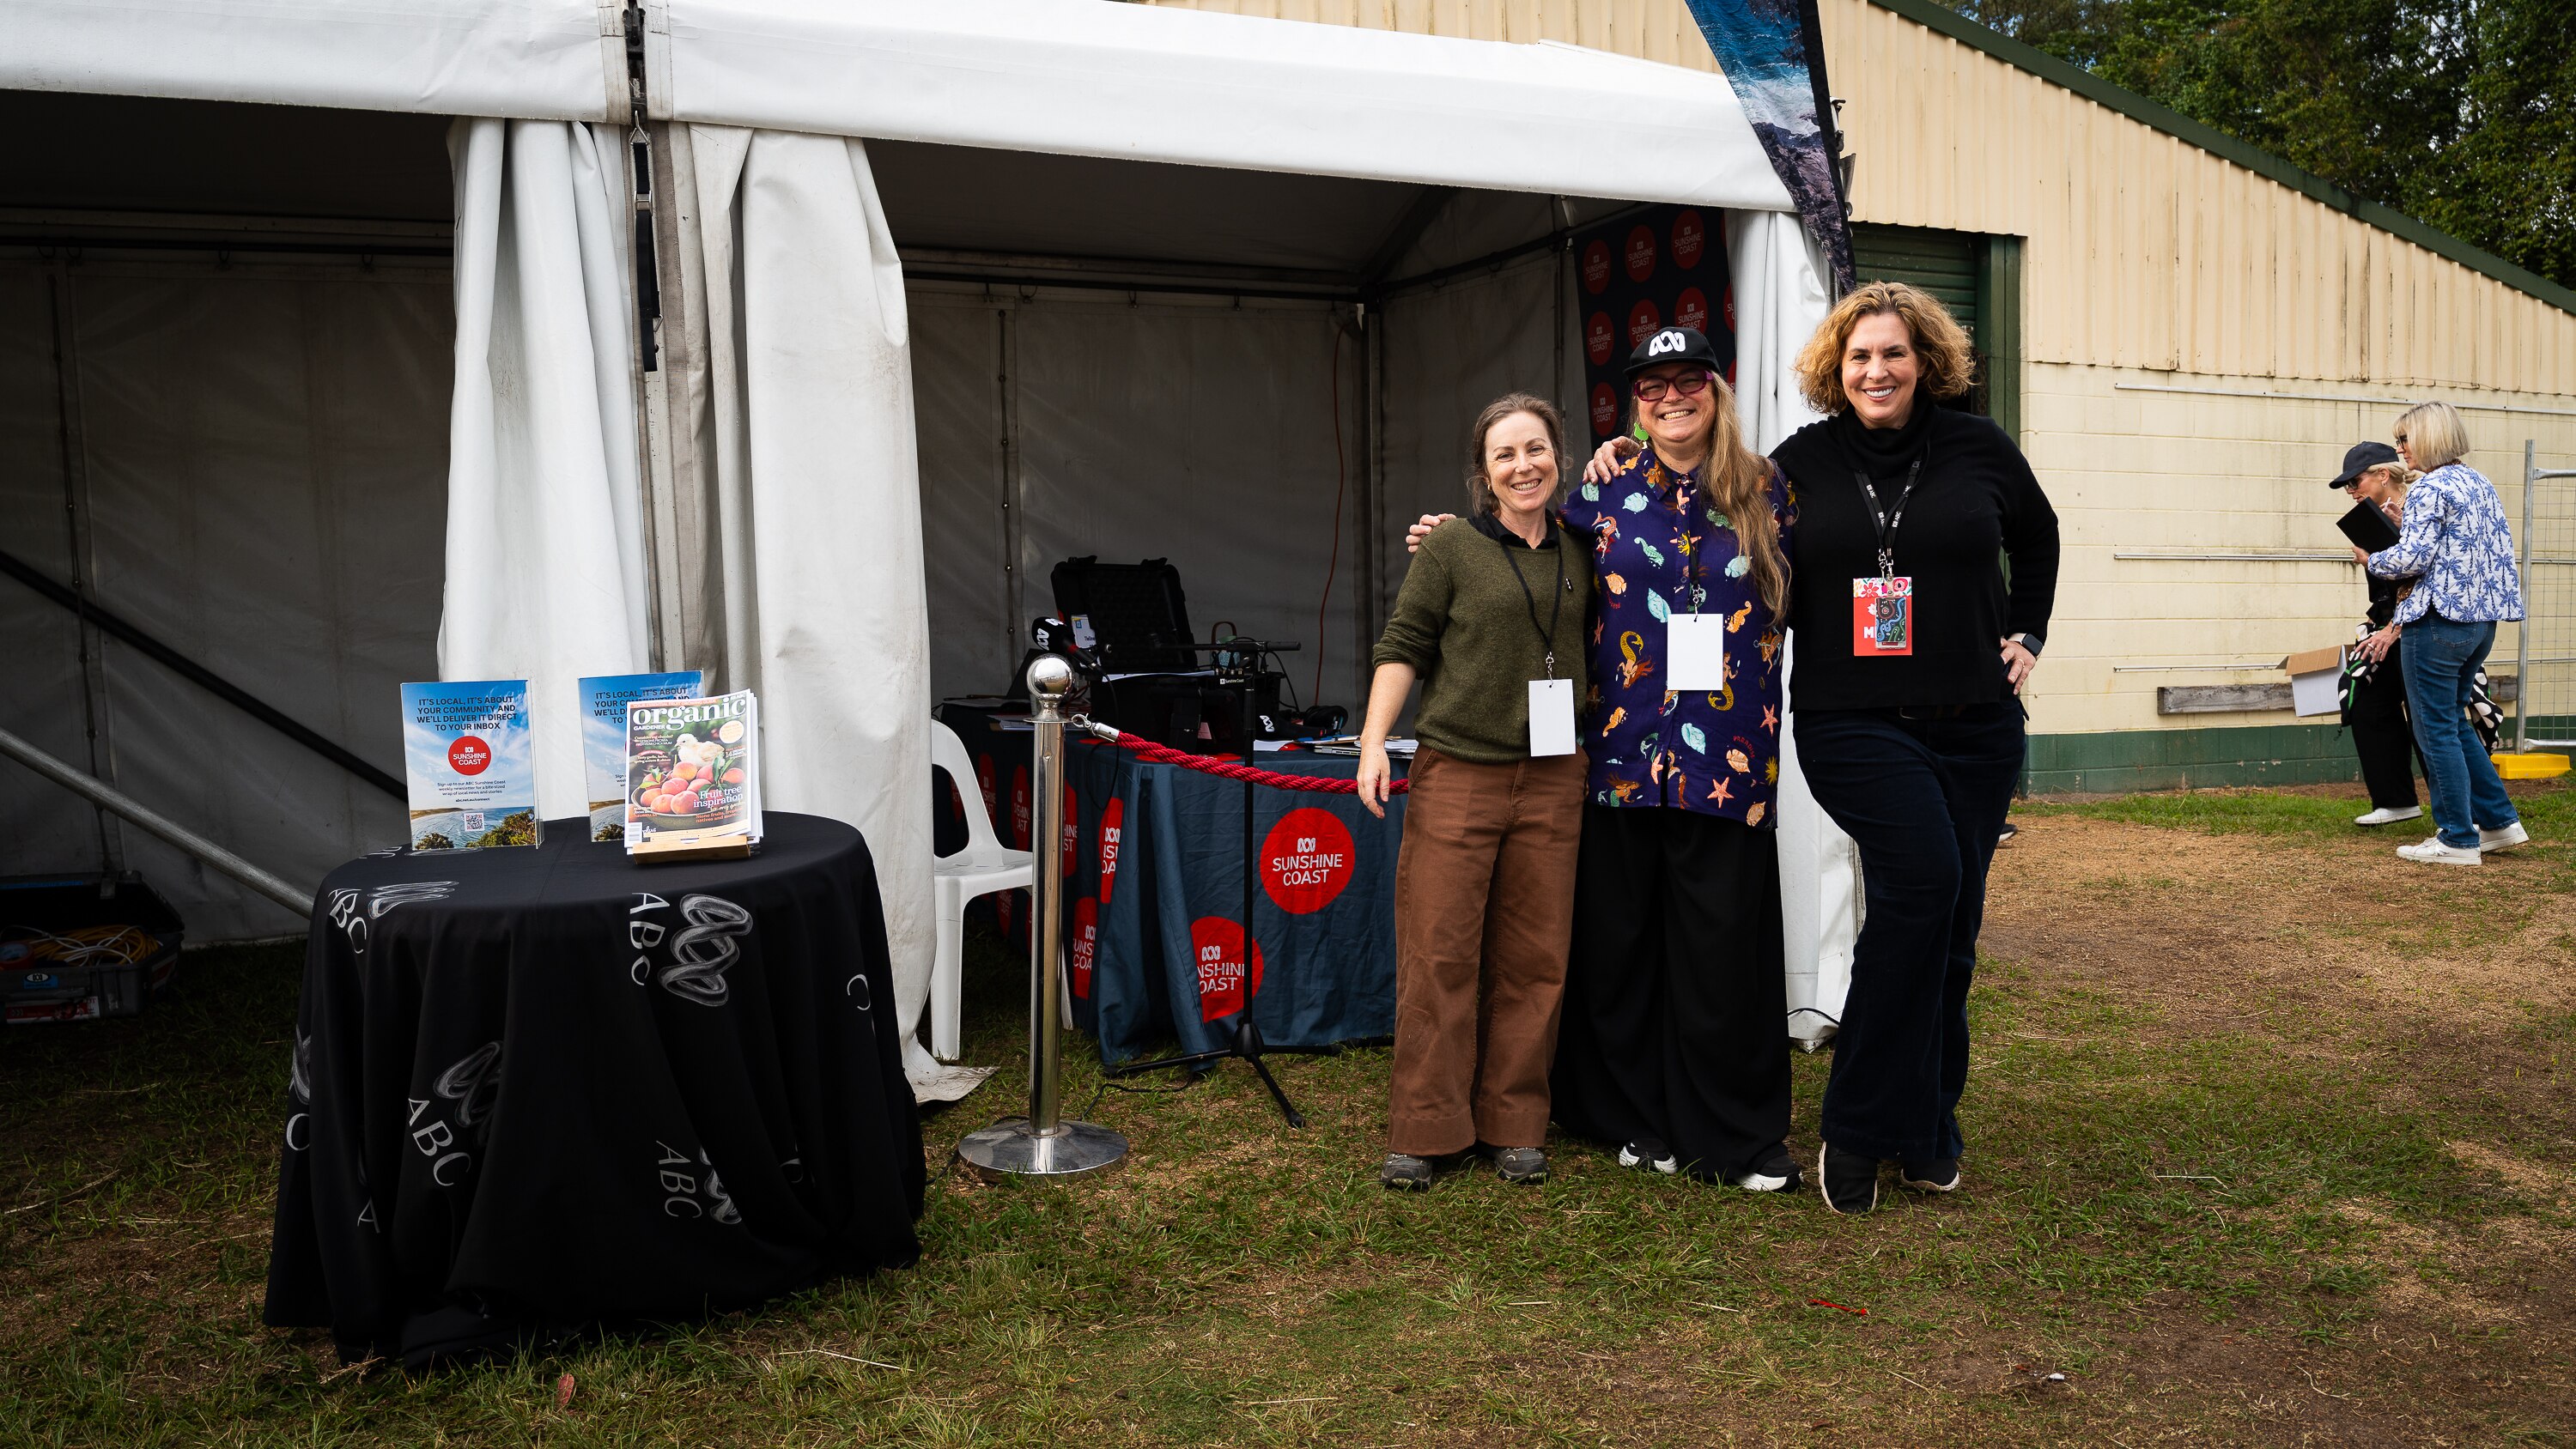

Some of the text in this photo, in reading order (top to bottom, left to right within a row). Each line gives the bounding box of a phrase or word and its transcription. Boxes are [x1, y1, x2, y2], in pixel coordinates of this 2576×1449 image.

[1674, 233, 1701, 247] SUNSHINE
[1628, 247, 1654, 262] SUNSHINE
[1679, 243, 1698, 255] COAST
[1585, 261, 1608, 275] SUNSHINE
[1631, 258, 1649, 269] COAST
[1589, 270, 1605, 282] COAST
[1678, 312, 1704, 324] SUNSHINE
[1631, 322, 1657, 335] SUNSHINE
[1589, 333, 1611, 346] SUNSHINE
[1592, 340, 1607, 351] COAST
[1593, 405, 1614, 415] SUNSHINE
[1596, 413, 1611, 422] COAST
[612, 690, 641, 699] LOCAL,
[642, 688, 658, 697] IT'S
[659, 687, 687, 695] ABOUT
[436, 697, 465, 706] LOCAL,
[594, 700, 618, 708] YOUR
[443, 714, 477, 723] DELIVER
[593, 708, 618, 717] WE'LL
[633, 697, 746, 731] organic
[700, 785, 742, 799] Fruit tree
[693, 793, 744, 808] inspiration
[1273, 853, 1343, 871] SUNSHINE
[1283, 868, 1330, 887] COAST
[328, 888, 367, 955] ABC
[629, 892, 671, 986] ABC
[1072, 954, 1093, 971] COA
[1197, 962, 1245, 979] NSHIN
[1199, 977, 1238, 995] OAST
[408, 1098, 471, 1186] ABC
[656, 1140, 703, 1219] ABC
